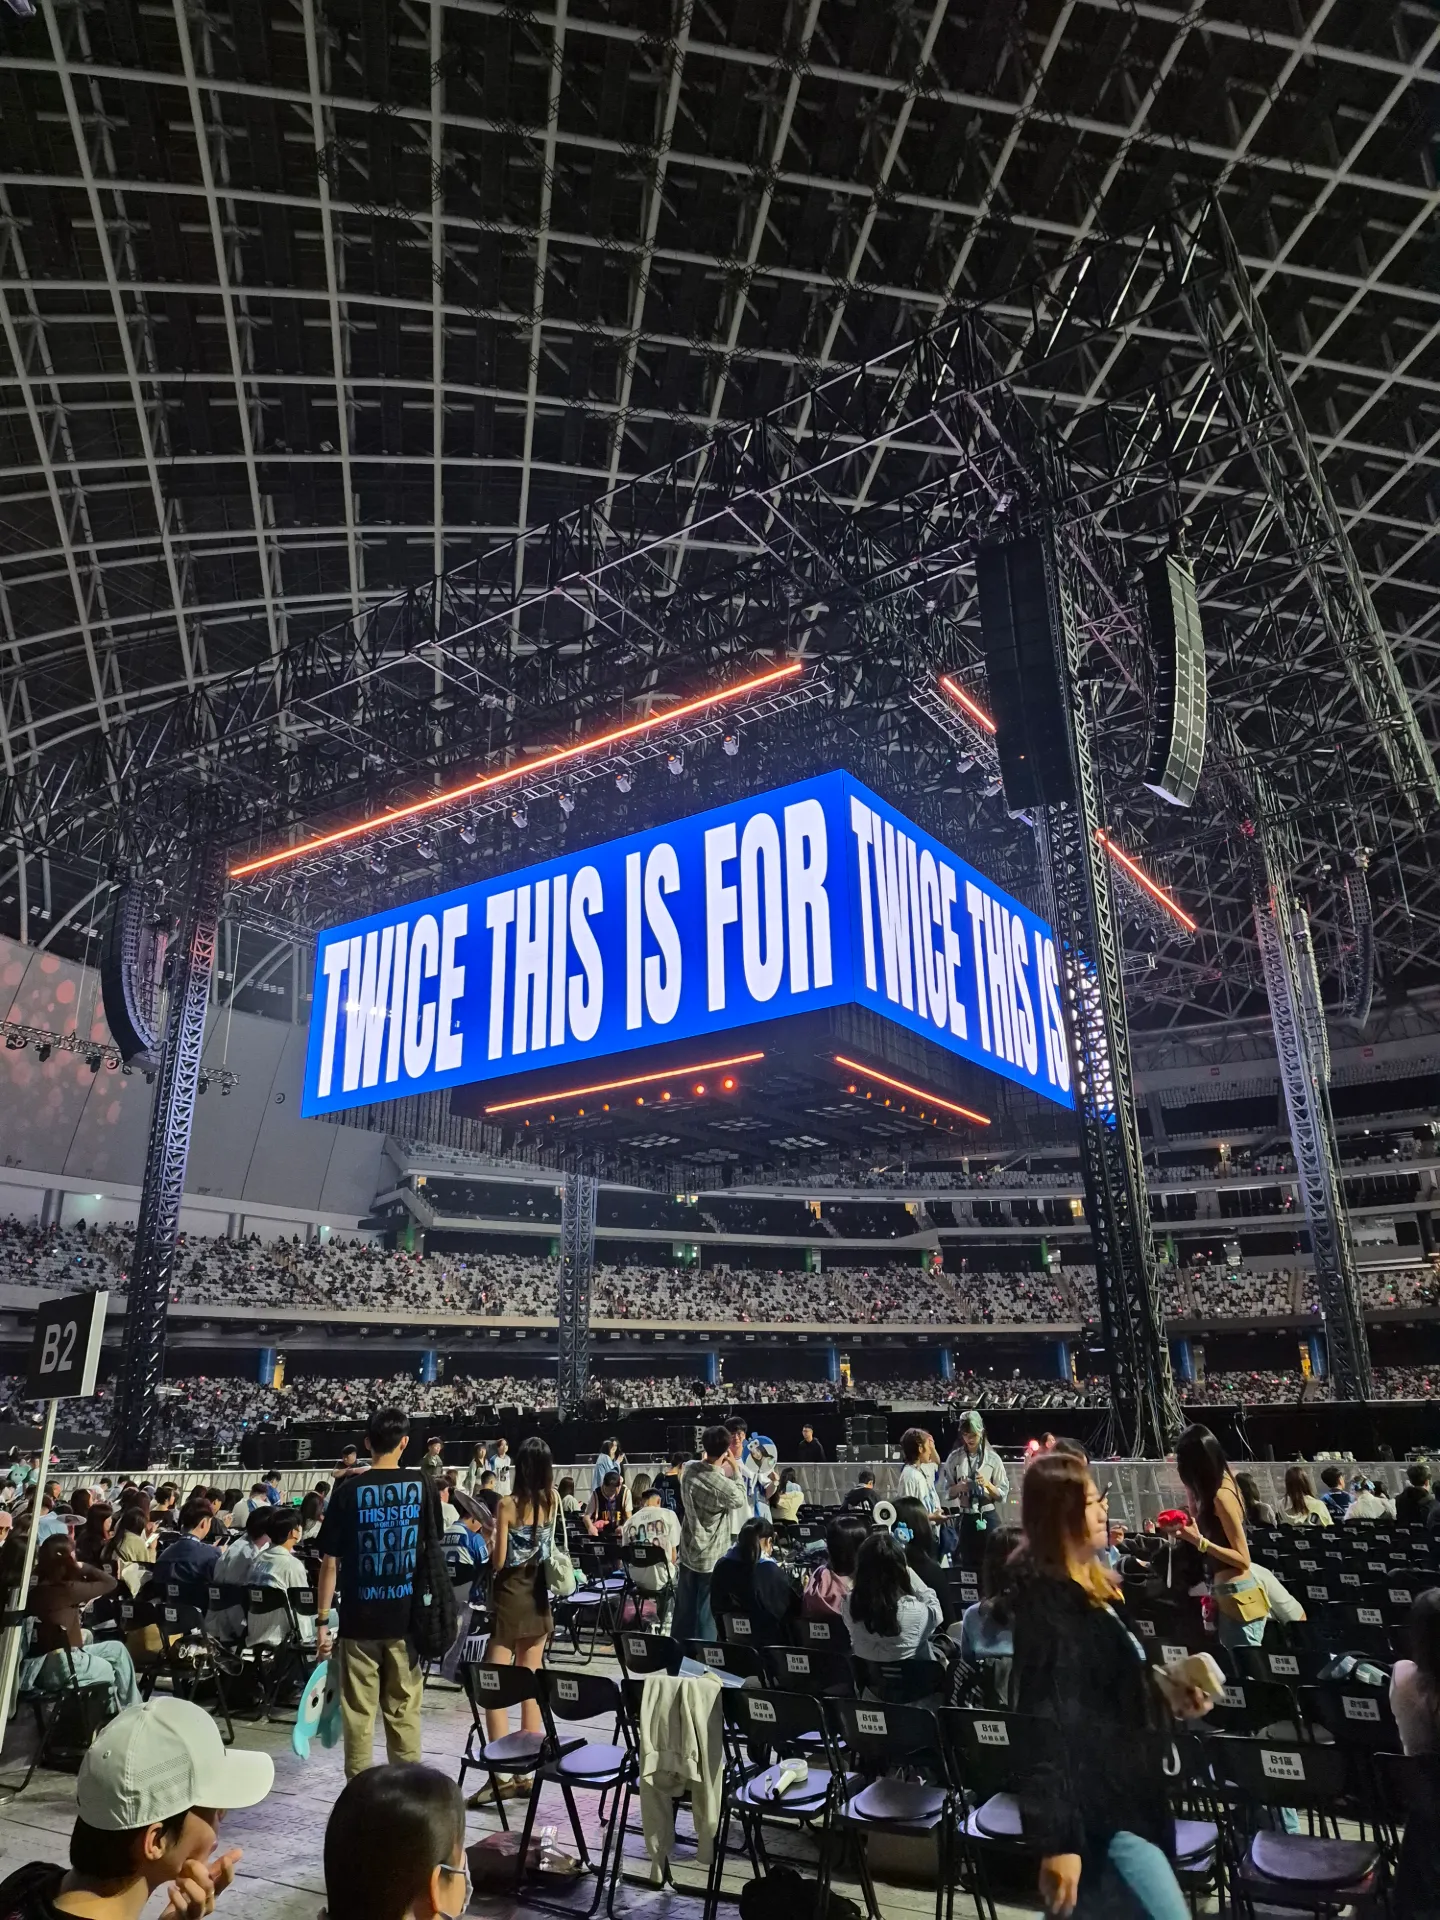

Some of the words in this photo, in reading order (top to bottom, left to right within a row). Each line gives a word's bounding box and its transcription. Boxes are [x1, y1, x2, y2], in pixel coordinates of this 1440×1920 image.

[317, 904, 468, 1098] TWICE
[486, 865, 604, 1060] THIS
[625, 842, 682, 1031] IS
[704, 798, 834, 1012] FOR
[850, 795, 967, 1041] TWICE
[966, 880, 1038, 1076] THIS
[39, 1320, 77, 1374] B2
[357, 1507, 385, 1524] THIS
[386, 1505, 399, 1521] IS
[399, 1504, 421, 1519] FOR
[1270, 1755, 1293, 1766] B1區
